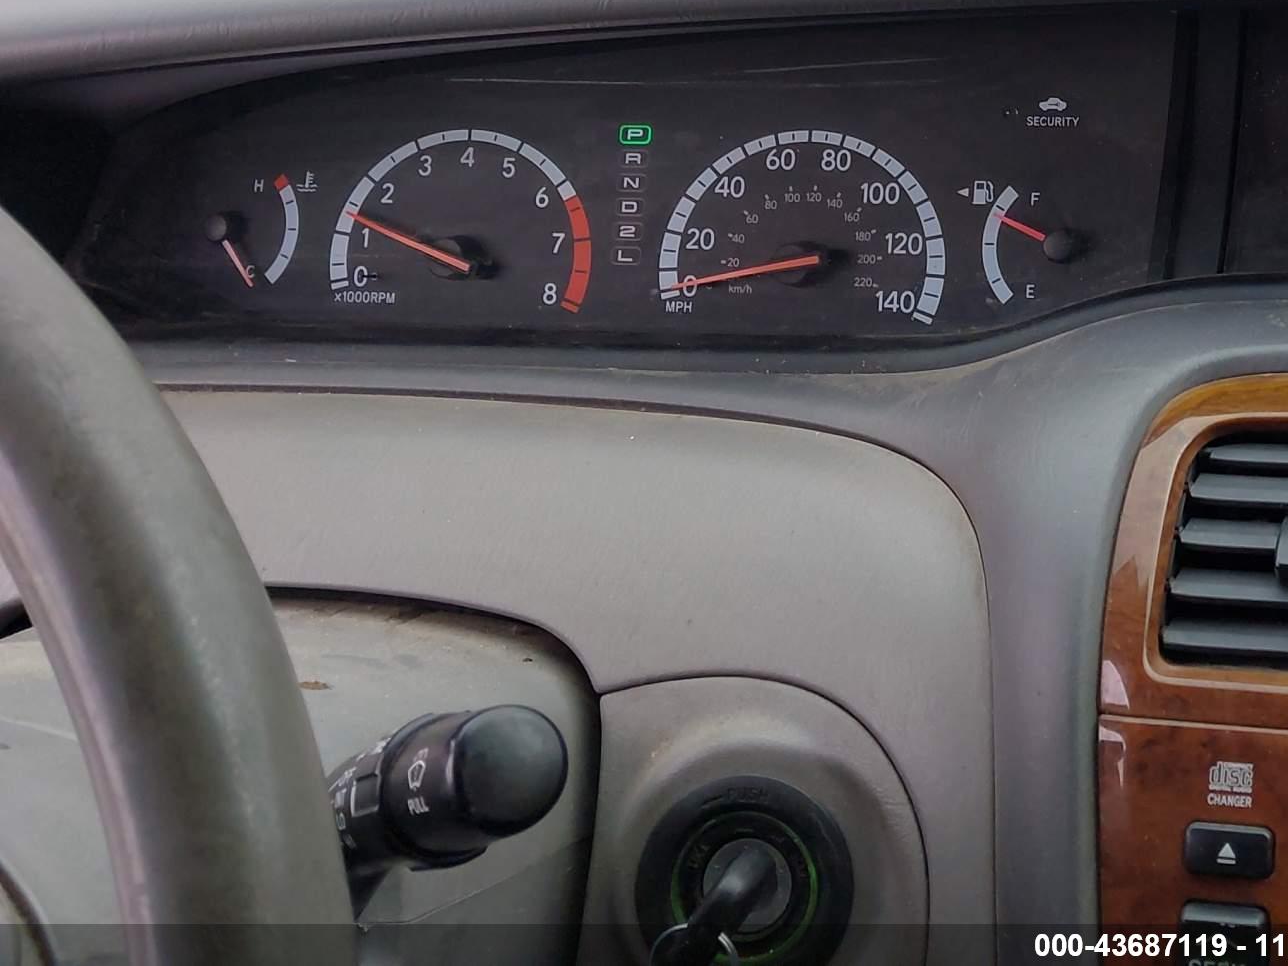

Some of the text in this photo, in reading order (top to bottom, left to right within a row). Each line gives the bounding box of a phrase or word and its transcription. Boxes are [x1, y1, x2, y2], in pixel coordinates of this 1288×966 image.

[1027, 116, 1079, 126] SECURITY
[626, 129, 644, 140] P
[461, 147, 474, 167] 4
[625, 153, 641, 164] R
[766, 149, 795, 170] 60
[822, 150, 850, 171] 80
[419, 156, 431, 175] 3
[503, 158, 515, 177] 5
[255, 180, 263, 192] H
[624, 177, 640, 188] N
[715, 177, 744, 197] 40
[381, 183, 394, 203] 2
[536, 187, 548, 207] 6
[785, 193, 800, 202] 100
[807, 193, 821, 202] 120
[861, 183, 899, 204] 100
[1031, 193, 1040, 205] F
[621, 201, 638, 213] D
[764, 200, 777, 210] 80
[827, 199, 842, 208] 140
[746, 214, 758, 224] 60
[845, 213, 859, 221] 160
[620, 225, 636, 237] 2
[856, 232, 871, 241] 180
[362, 228, 369, 247] 1
[553, 233, 565, 253] 7
[686, 228, 714, 249] 20
[732, 234, 744, 243] 40
[886, 233, 922, 254] 120
[618, 250, 633, 261] L
[858, 254, 875, 264] 200
[728, 258, 739, 267] 20
[354, 266, 367, 286] 0
[854, 277, 872, 287] 220
[682, 275, 698, 297] 0
[729, 285, 752, 293] km/h
[1026, 285, 1034, 298] E
[543, 283, 556, 304] 8
[666, 301, 692, 312] MPH
[876, 291, 914, 313] 140
[1208, 793, 1252, 807] CHANGER
